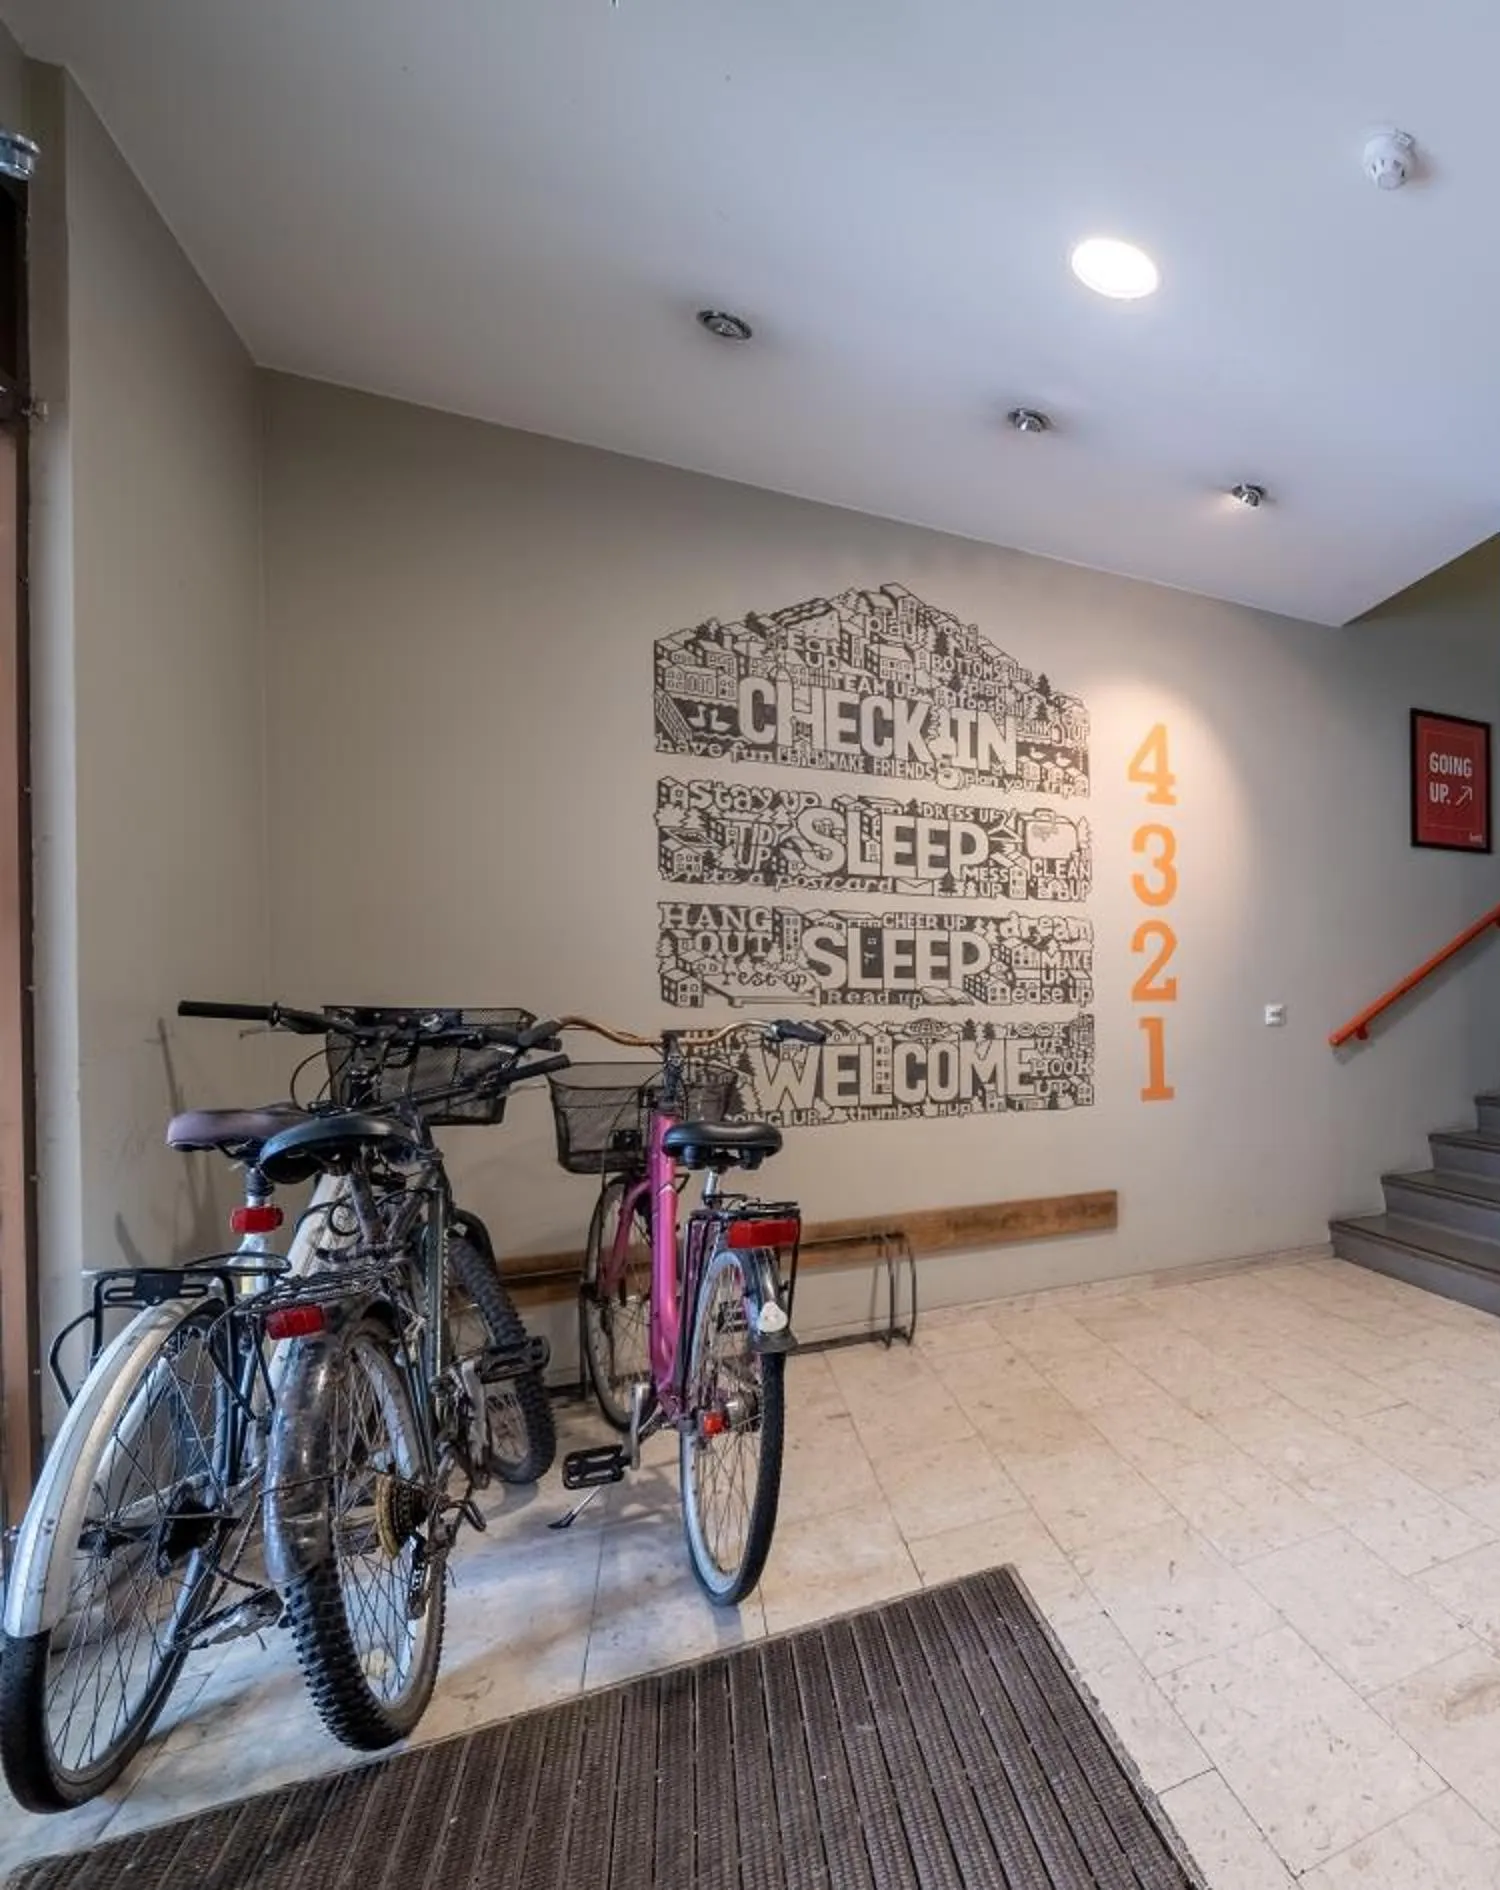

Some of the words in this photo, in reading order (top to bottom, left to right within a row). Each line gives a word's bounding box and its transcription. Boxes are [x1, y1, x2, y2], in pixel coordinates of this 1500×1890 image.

[830, 672, 887, 696] TEAM
[739, 677, 933, 763] CHECK
[948, 704, 1016, 774] IN
[656, 732, 723, 757] have
[730, 741, 774, 763] fun
[827, 752, 866, 773] MAKE
[873, 757, 936, 780] FRIENDS
[1128, 722, 1176, 805] 4
[1429, 752, 1472, 777] GOING
[965, 771, 1000, 788] plan
[1003, 780, 1040, 794] your
[1043, 776, 1075, 799] trip
[923, 802, 975, 821] DRESS
[979, 808, 1000, 823] UP
[732, 823, 791, 847] TIDY
[798, 807, 990, 879] SLEEP
[738, 846, 771, 870] UP
[1031, 859, 1092, 879] CLEAN
[1131, 823, 1177, 907] 3
[750, 872, 765, 884] a
[774, 873, 894, 894] postcard
[961, 866, 1008, 883] MESS
[980, 881, 1001, 898] UP
[1069, 878, 1091, 900] UP
[659, 903, 773, 932] HANG
[882, 913, 940, 929] CHEER
[943, 916, 967, 930] UP
[1000, 911, 1093, 941] dream
[694, 931, 772, 957] OUT
[801, 926, 990, 990] SLEEP
[1040, 950, 1093, 971] MAKE
[1131, 920, 1177, 1001] 2
[722, 970, 779, 986] rest
[1041, 968, 1069, 985] UP
[828, 989, 890, 1005] Read
[899, 991, 923, 1009] up
[1012, 986, 1065, 1003] ease
[1007, 1023, 1066, 1037] LOOK
[1030, 1058, 1094, 1077] HOOK
[1138, 1017, 1175, 1102] 1
[752, 1040, 1036, 1109] WELCOME
[1036, 1079, 1071, 1097] UP
[850, 1104, 921, 1121] thumbs
[948, 1103, 972, 1118] up
